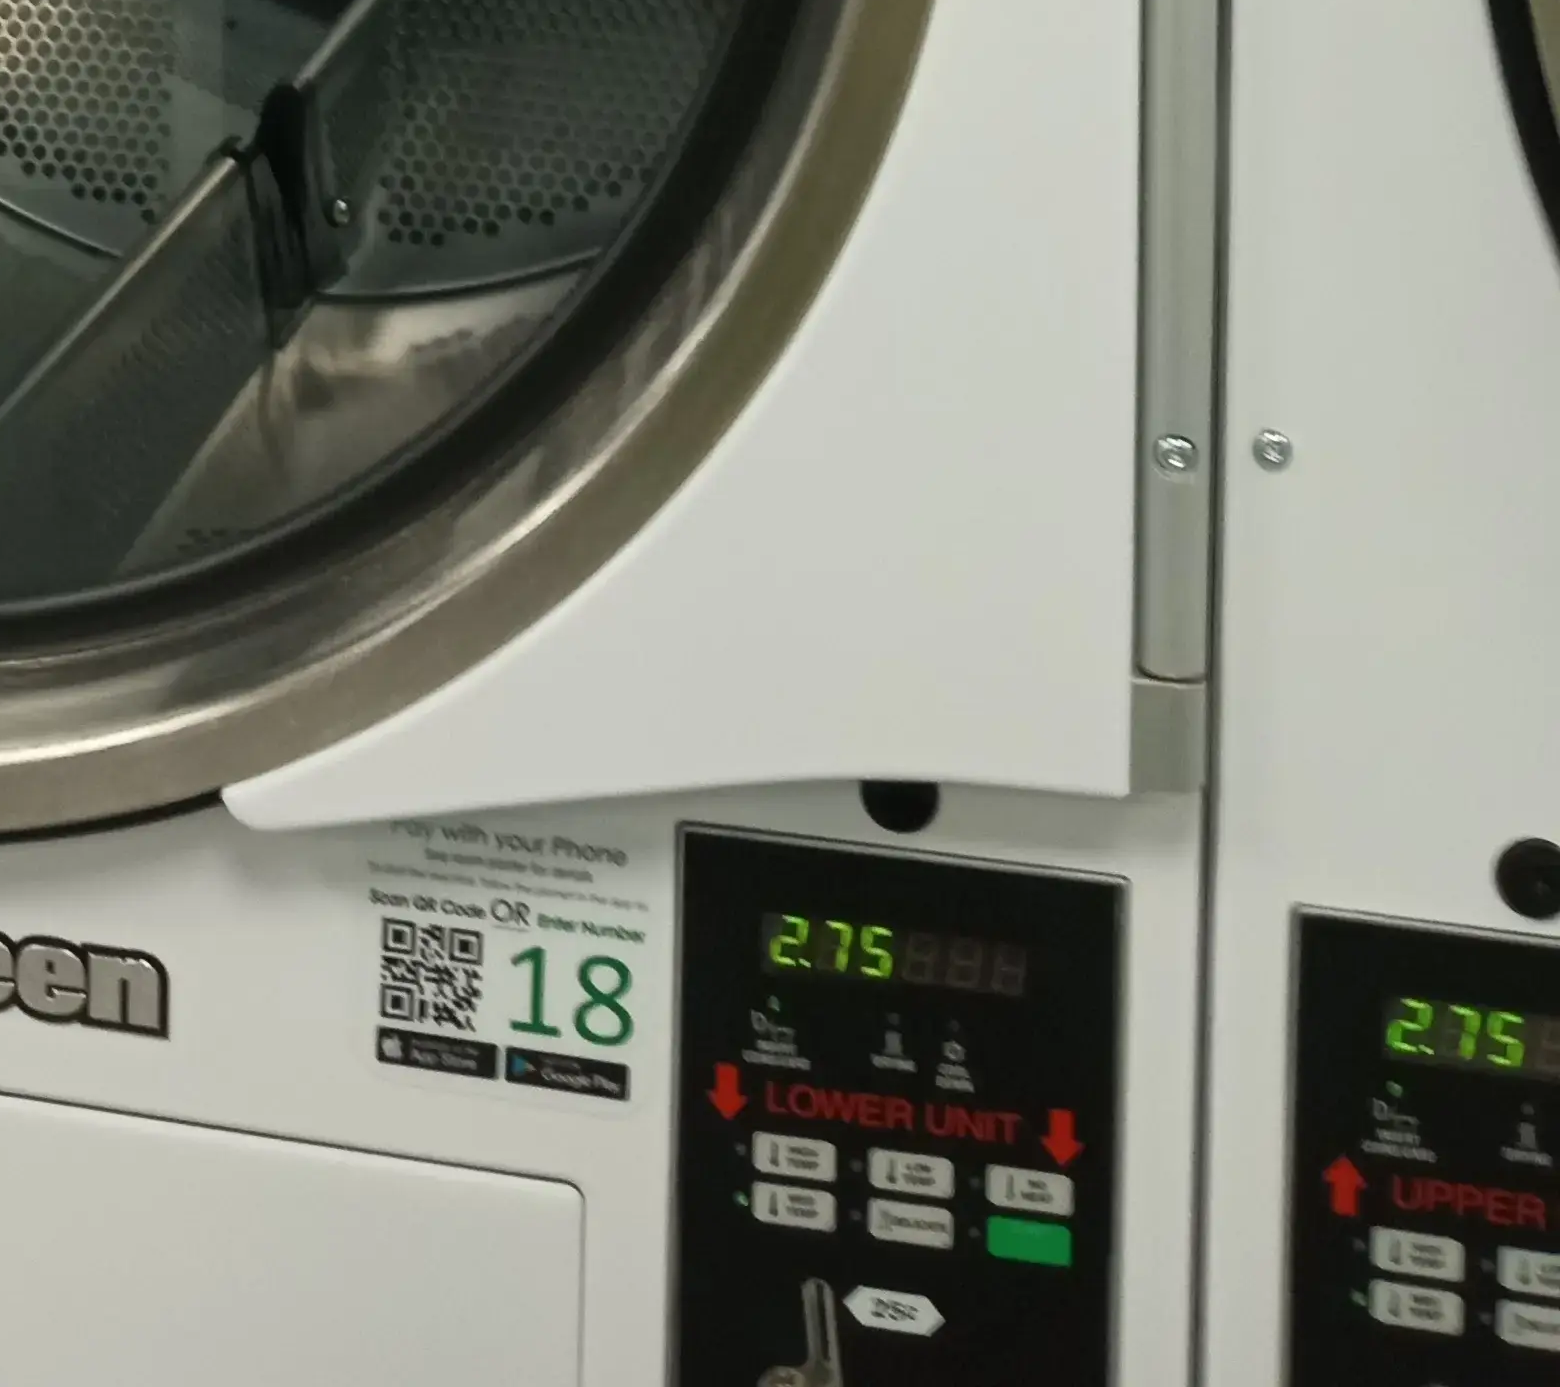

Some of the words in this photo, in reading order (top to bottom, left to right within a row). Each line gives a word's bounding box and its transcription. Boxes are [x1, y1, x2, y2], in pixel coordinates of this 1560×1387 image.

[493, 832, 546, 855] your
[550, 835, 629, 867] Phone
[490, 898, 532, 927] OR
[768, 914, 895, 979] 2.75
[508, 944, 635, 1047] 18
[1385, 998, 1526, 1067] 2.75
[765, 1080, 916, 1130] LOWER
[924, 1102, 1023, 1145] UNIT
[1393, 1174, 1547, 1231] UPPER
